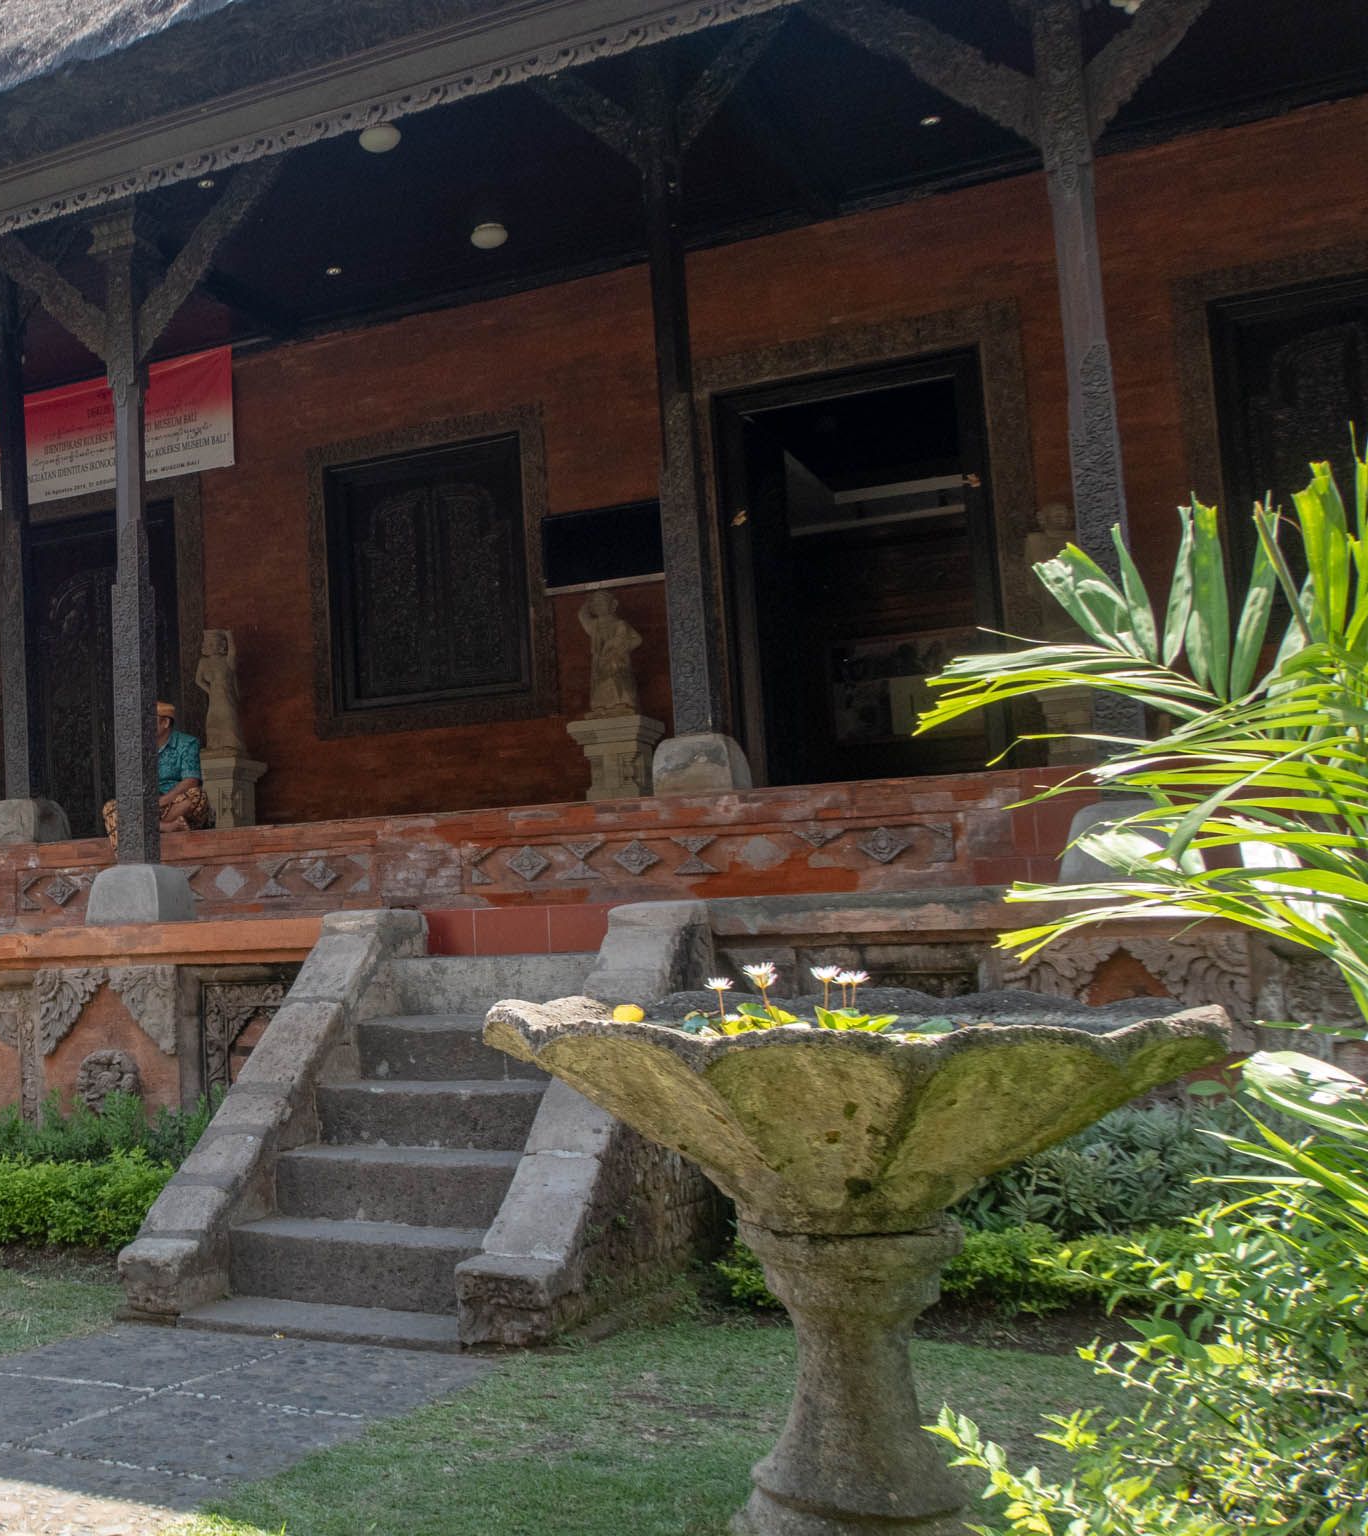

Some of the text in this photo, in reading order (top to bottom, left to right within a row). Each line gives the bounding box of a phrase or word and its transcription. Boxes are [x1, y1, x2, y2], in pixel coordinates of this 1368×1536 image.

[154, 416, 182, 430] MUSEUM
[183, 410, 198, 424] BALI
[57, 464, 89, 479] IDENTITAS
[155, 442, 181, 457] KOLEKSI
[181, 436, 210, 451] MUSEUM
[160, 463, 185, 472] MUSEUM
[186, 459, 200, 467] BALI
